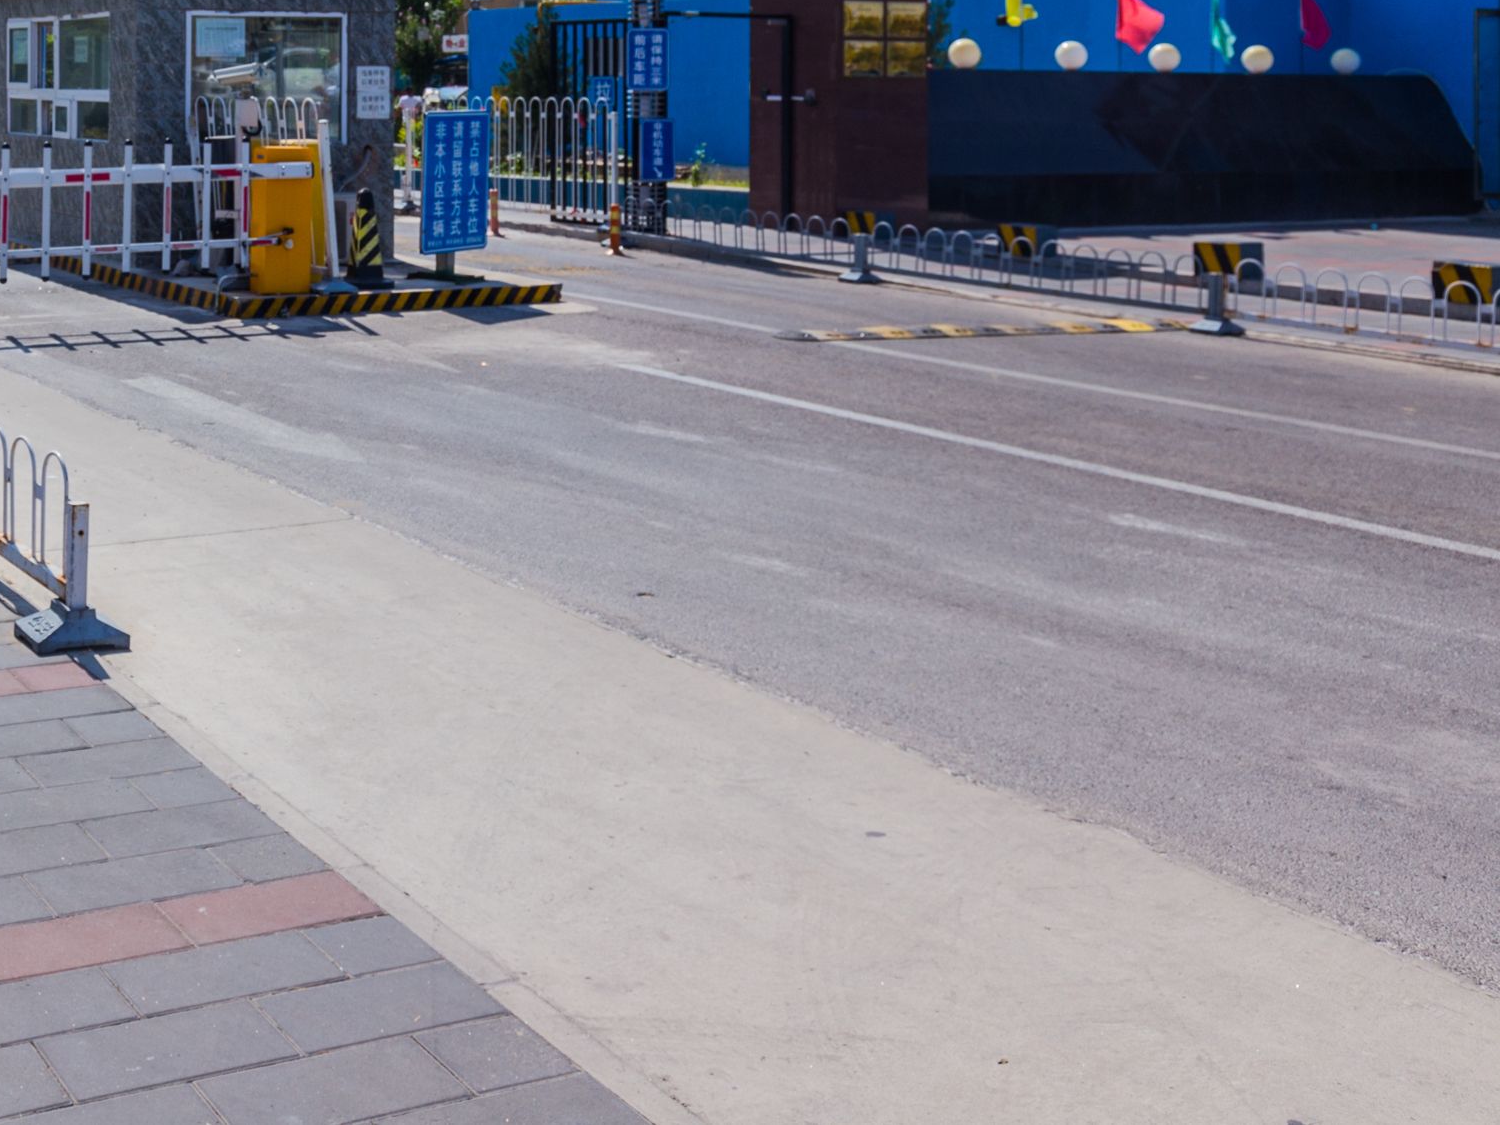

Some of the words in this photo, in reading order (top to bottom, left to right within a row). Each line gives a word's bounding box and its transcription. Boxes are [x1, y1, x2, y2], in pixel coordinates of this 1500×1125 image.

[633, 34, 646, 86] 前后车距
[651, 34, 663, 86] 请保持三米
[432, 121, 447, 237] 非本小区车辆
[450, 120, 465, 236] 请留联系方式
[467, 120, 481, 234] 禁占他人车位
